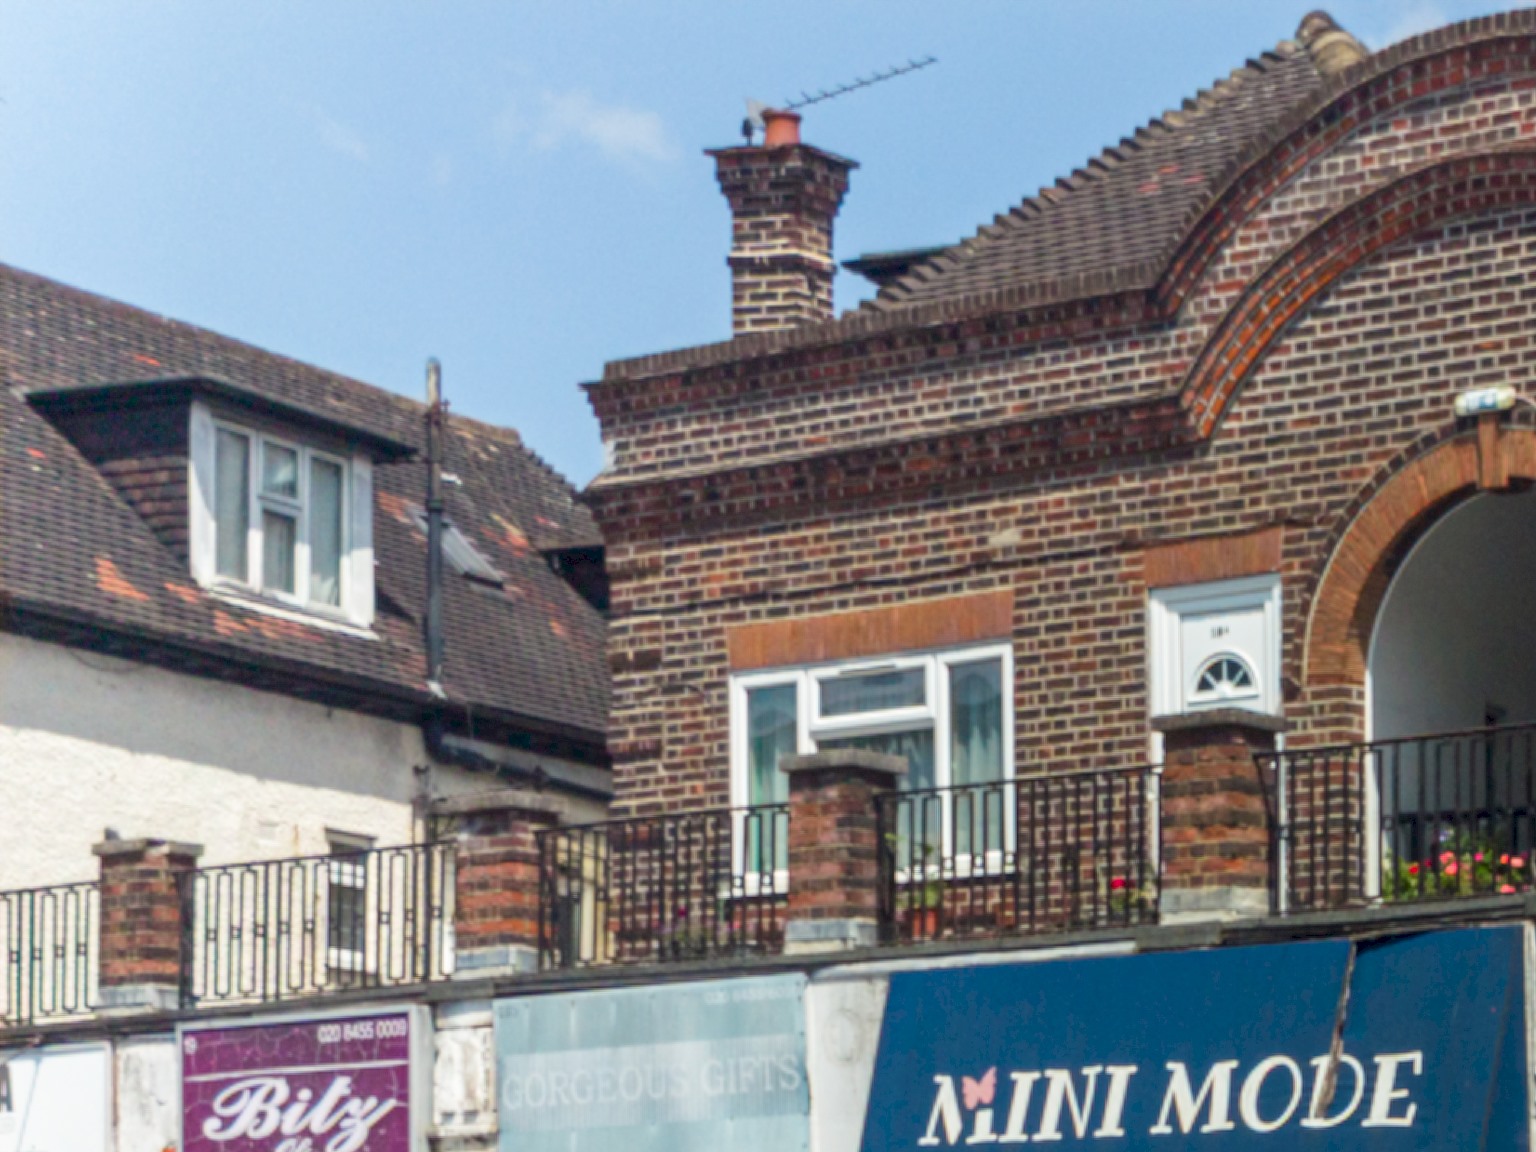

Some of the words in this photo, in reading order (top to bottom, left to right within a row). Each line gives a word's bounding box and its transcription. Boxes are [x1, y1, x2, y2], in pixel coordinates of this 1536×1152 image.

[501, 1060, 694, 1112] GORGEOUS
[700, 1053, 801, 1096] GIFTS
[917, 1064, 1138, 1147] MINI
[1149, 1050, 1424, 1137] MODE
